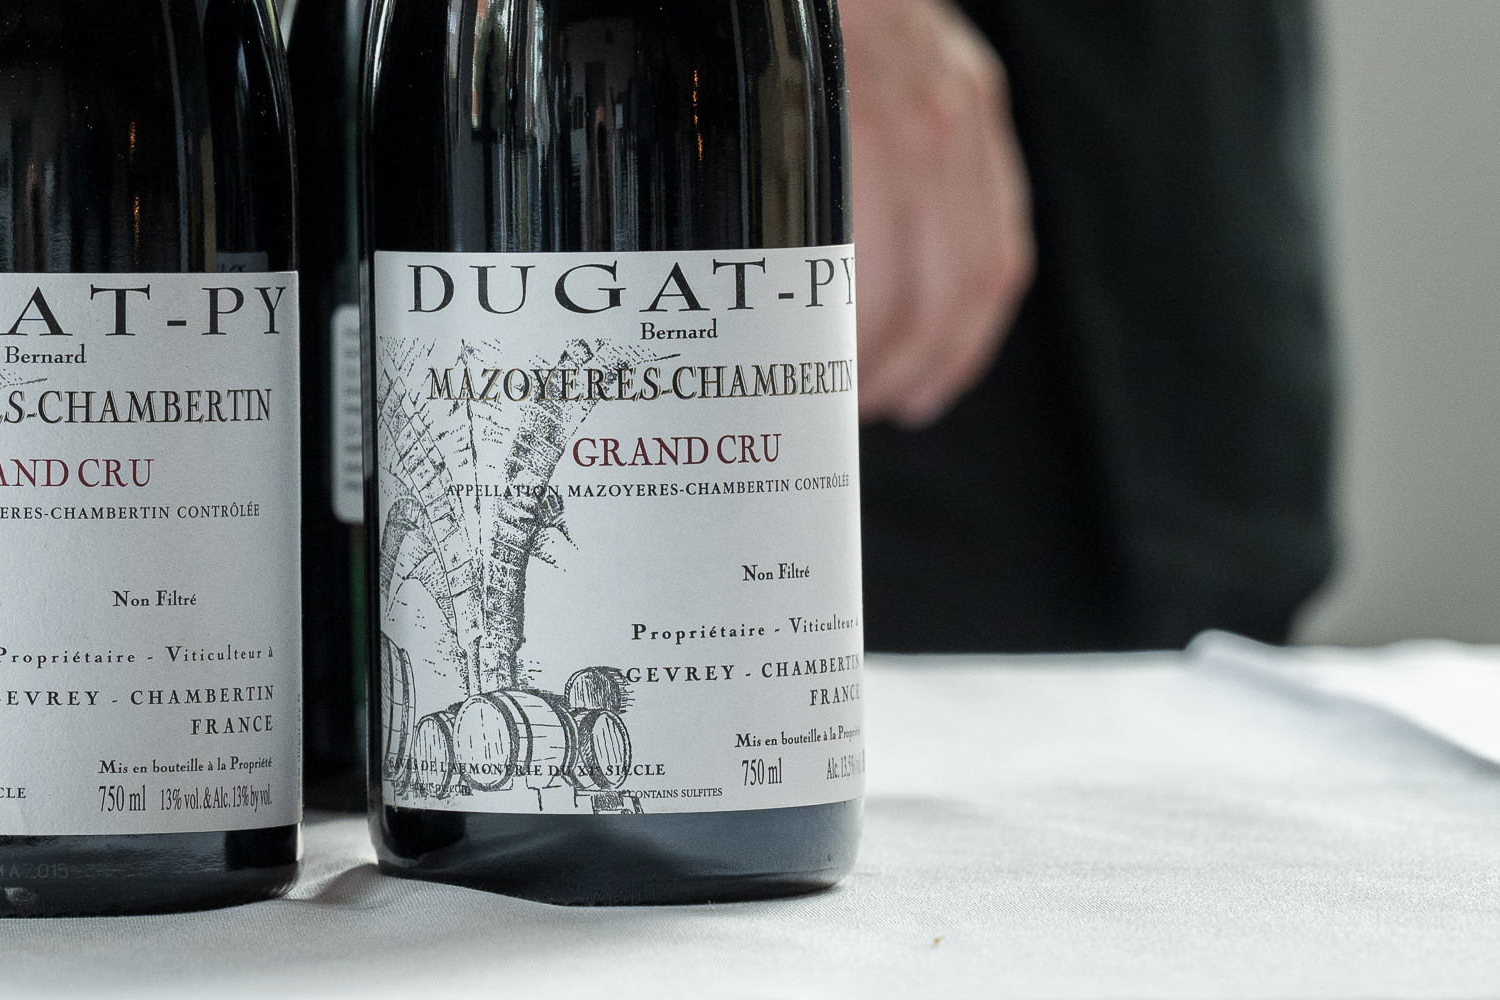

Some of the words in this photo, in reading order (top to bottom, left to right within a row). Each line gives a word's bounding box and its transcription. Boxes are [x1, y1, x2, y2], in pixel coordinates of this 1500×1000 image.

[408, 258, 855, 314] DUGAT-PY
[640, 318, 718, 340] Bernard
[4, 344, 87, 365] Bernard
[572, 435, 709, 467] GRAND
[716, 433, 783, 464] CRU
[78, 457, 155, 488] CRU
[445, 484, 560, 498] APPELLATION
[568, 479, 790, 498] MAZOYERES-CHAMBERTIN
[794, 474, 850, 492] CONTRÔLÉE
[177, 500, 261, 518] CONTRÔLÉE
[742, 564, 774, 581] Non
[778, 562, 810, 580] Filtré
[112, 590, 150, 607] Non
[155, 589, 197, 606] Filtré
[631, 623, 765, 645] Propriétaire
[789, 614, 854, 634] Viticulteur
[165, 644, 263, 662] Viticulteur
[626, 665, 734, 683] GEVREY
[761, 653, 860, 678] CHAMBERTIN
[130, 684, 275, 706] CHAMBERTIN
[810, 683, 860, 706] FRANCE
[191, 715, 274, 736] FRANCE
[735, 733, 761, 748] Mis
[765, 737, 778, 746] en
[781, 728, 821, 745] bouteille
[830, 726, 837, 741] la
[98, 760, 129, 774] Mis
[133, 766, 148, 774] en
[152, 757, 204, 773] bouteille
[207, 761, 214, 771] à
[217, 757, 227, 771] la
[230, 756, 273, 774] Propriété
[742, 758, 765, 786] 750
[768, 757, 782, 785] ml
[98, 785, 125, 812] 750
[129, 784, 147, 812] ml
[160, 787, 182, 811] 13%
[203, 787, 212, 810] &
[213, 786, 231, 809] Alc.
[629, 789, 678, 800] CONTAINS
[681, 788, 723, 798] SULFITES
